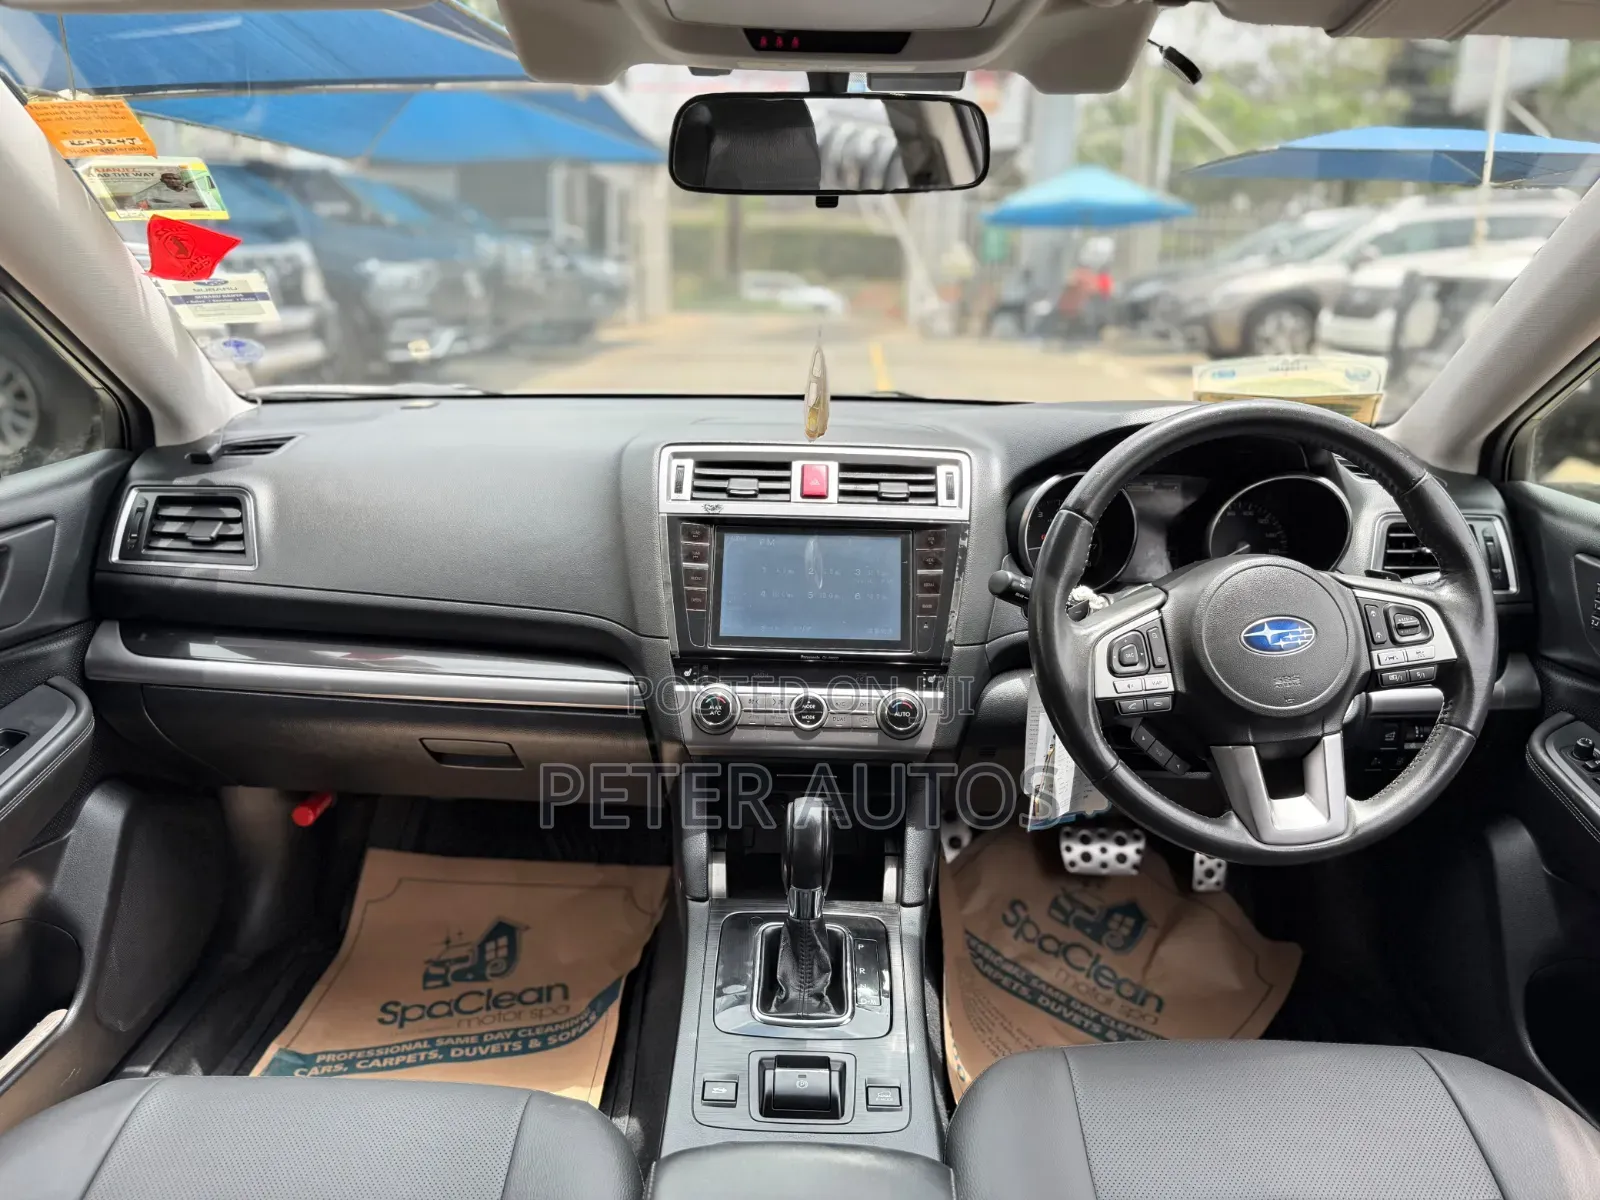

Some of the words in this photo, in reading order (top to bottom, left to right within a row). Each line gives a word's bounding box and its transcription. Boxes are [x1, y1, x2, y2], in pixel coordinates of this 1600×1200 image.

[807, 567, 815, 575] 2
[854, 568, 861, 576] 3
[807, 591, 814, 599] 5
[854, 592, 861, 600] 6
[1002, 898, 1165, 1014] SpaClean
[859, 967, 866, 975] R
[377, 982, 570, 1029] SpaClean
[1029, 977, 1069, 1003] SAME
[1069, 999, 1099, 1018] DAY
[457, 1009, 526, 1029] motor
[529, 1004, 571, 1022] spa
[1036, 996, 1101, 1033] DUVETS
[315, 1040, 431, 1063] PROFESSIONAL
[435, 1035, 479, 1046] SAME
[483, 1030, 514, 1042] DAY
[355, 1049, 443, 1069] CARPETS,
[450, 1041, 522, 1058] DUVETS
[527, 1037, 542, 1049] &
[547, 1011, 598, 1045] SOFAS
